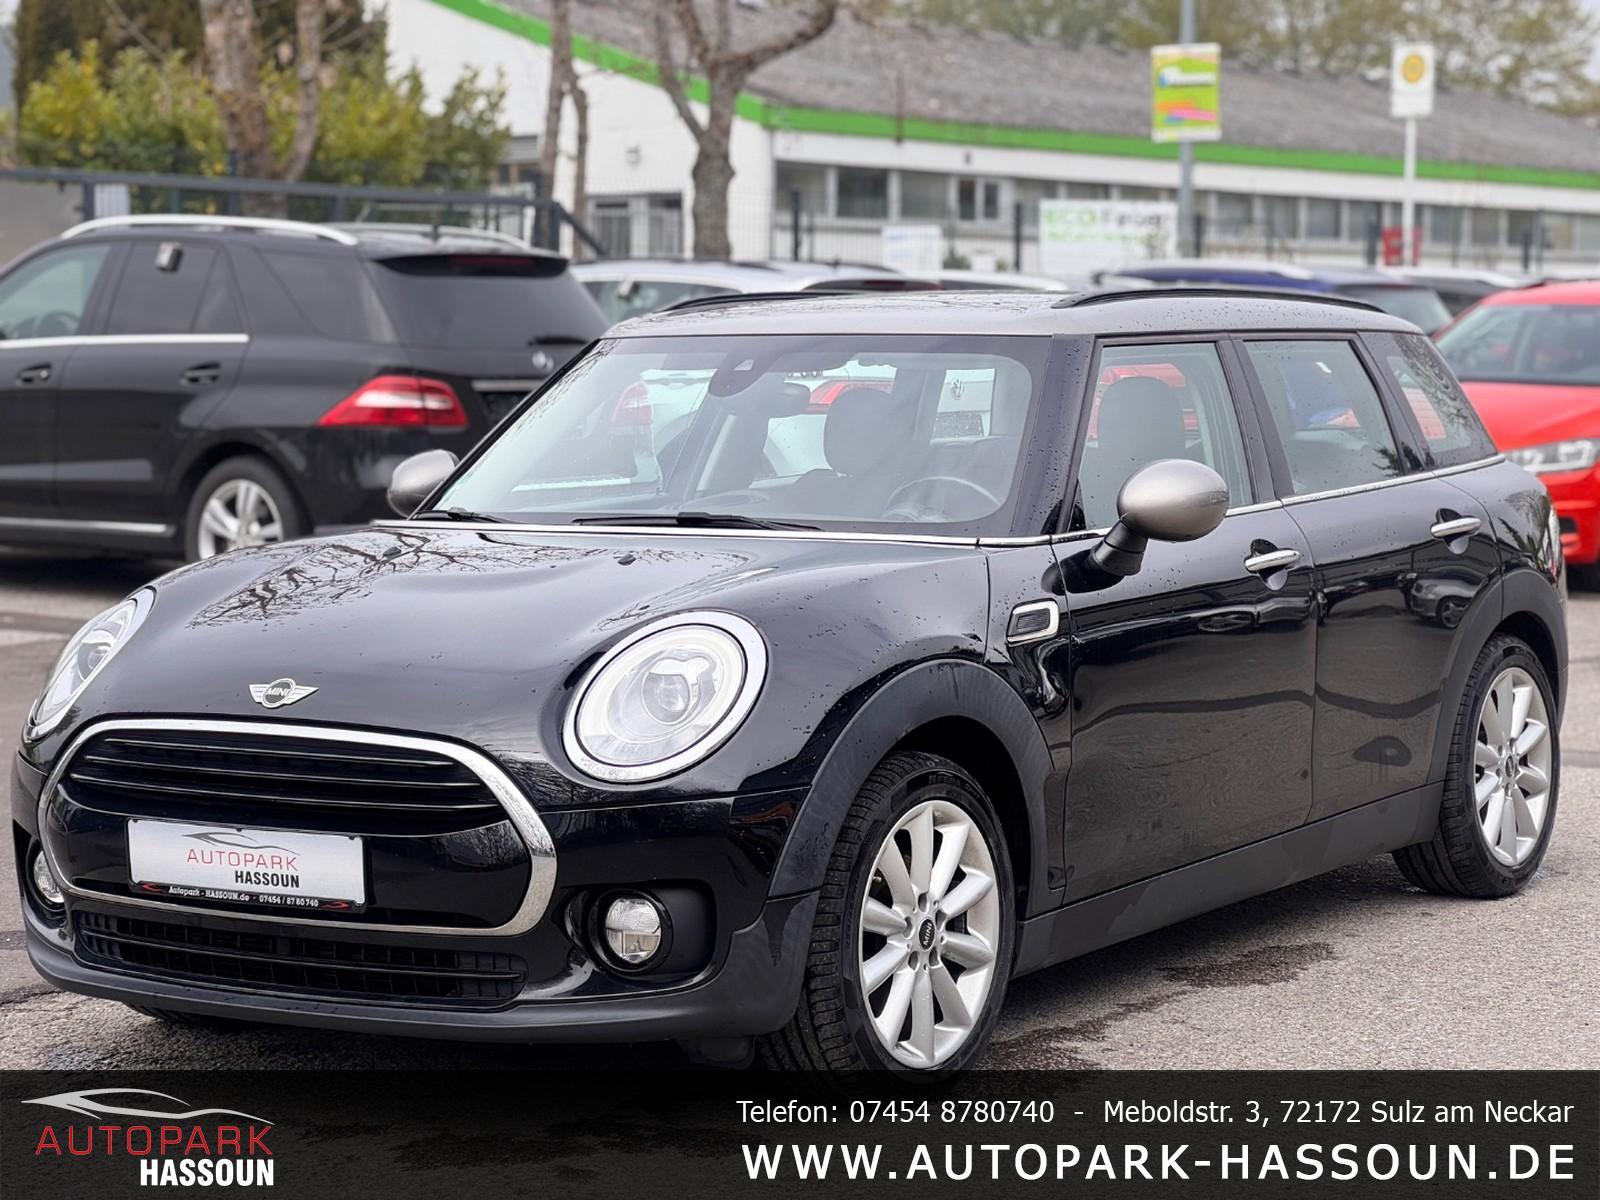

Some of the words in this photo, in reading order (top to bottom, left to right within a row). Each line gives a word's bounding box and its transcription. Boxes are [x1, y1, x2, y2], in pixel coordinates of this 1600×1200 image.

[266, 687, 291, 697] MINI
[186, 848, 299, 872] AUTOPARK
[235, 870, 300, 889] HASSOUN
[168, 885, 201, 897] Autopark
[205, 889, 250, 902] HASSOUN.de
[922, 922, 933, 946] MINI
